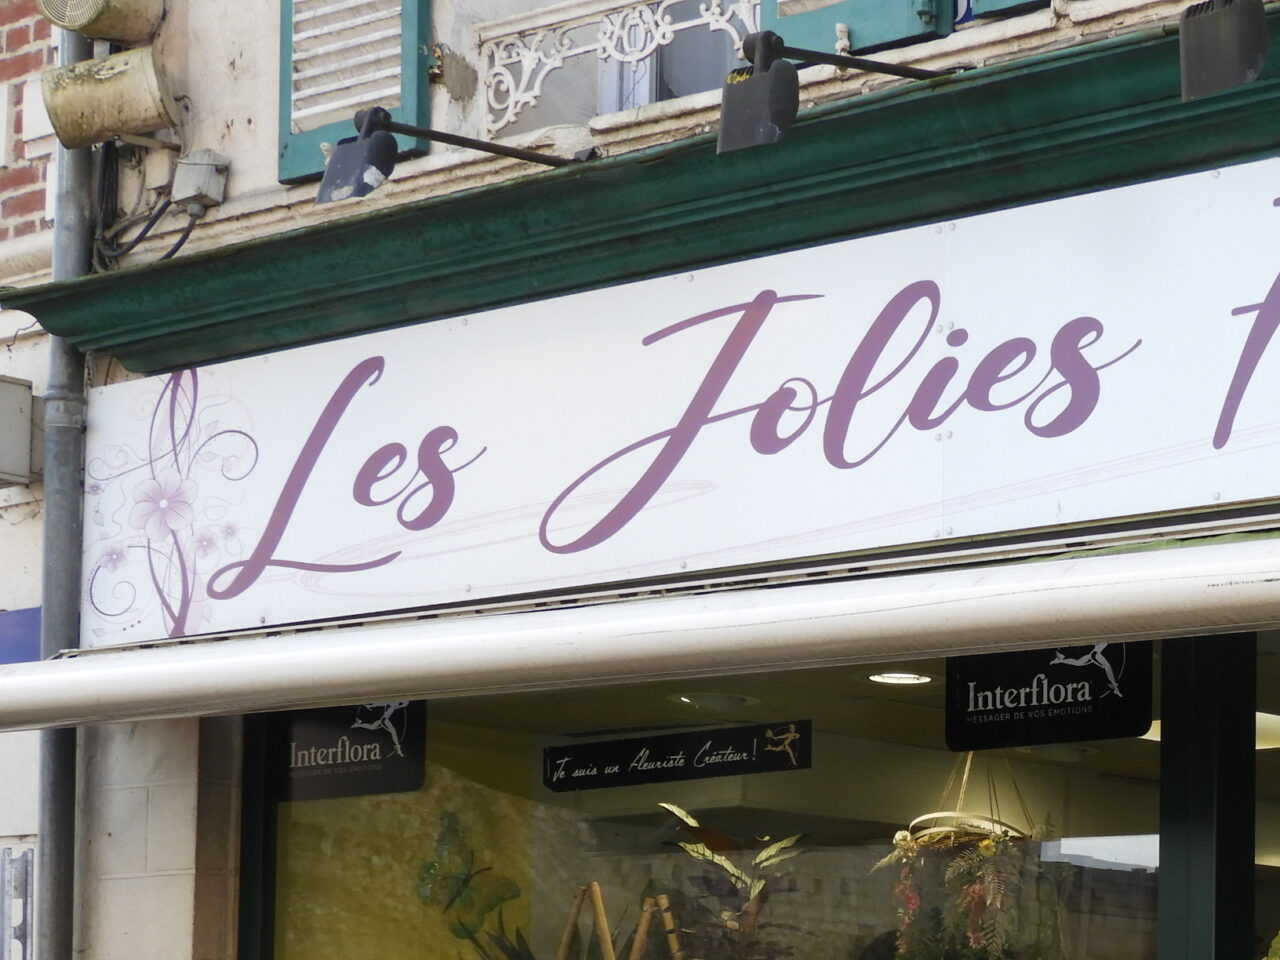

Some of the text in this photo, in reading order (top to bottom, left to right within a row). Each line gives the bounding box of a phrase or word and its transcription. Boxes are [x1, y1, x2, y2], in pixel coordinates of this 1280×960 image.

[207, 355, 486, 600] Les
[539, 279, 1142, 554] Jolies
[967, 673, 1093, 712] Interflora
[966, 712, 1011, 724] MESSAGER
[1014, 711, 1025, 720] DE
[1028, 709, 1045, 718] VOS
[290, 735, 382, 768] Interflora
[553, 757, 573, 782] Je
[571, 765, 597, 777] suis
[604, 765, 620, 775] un
